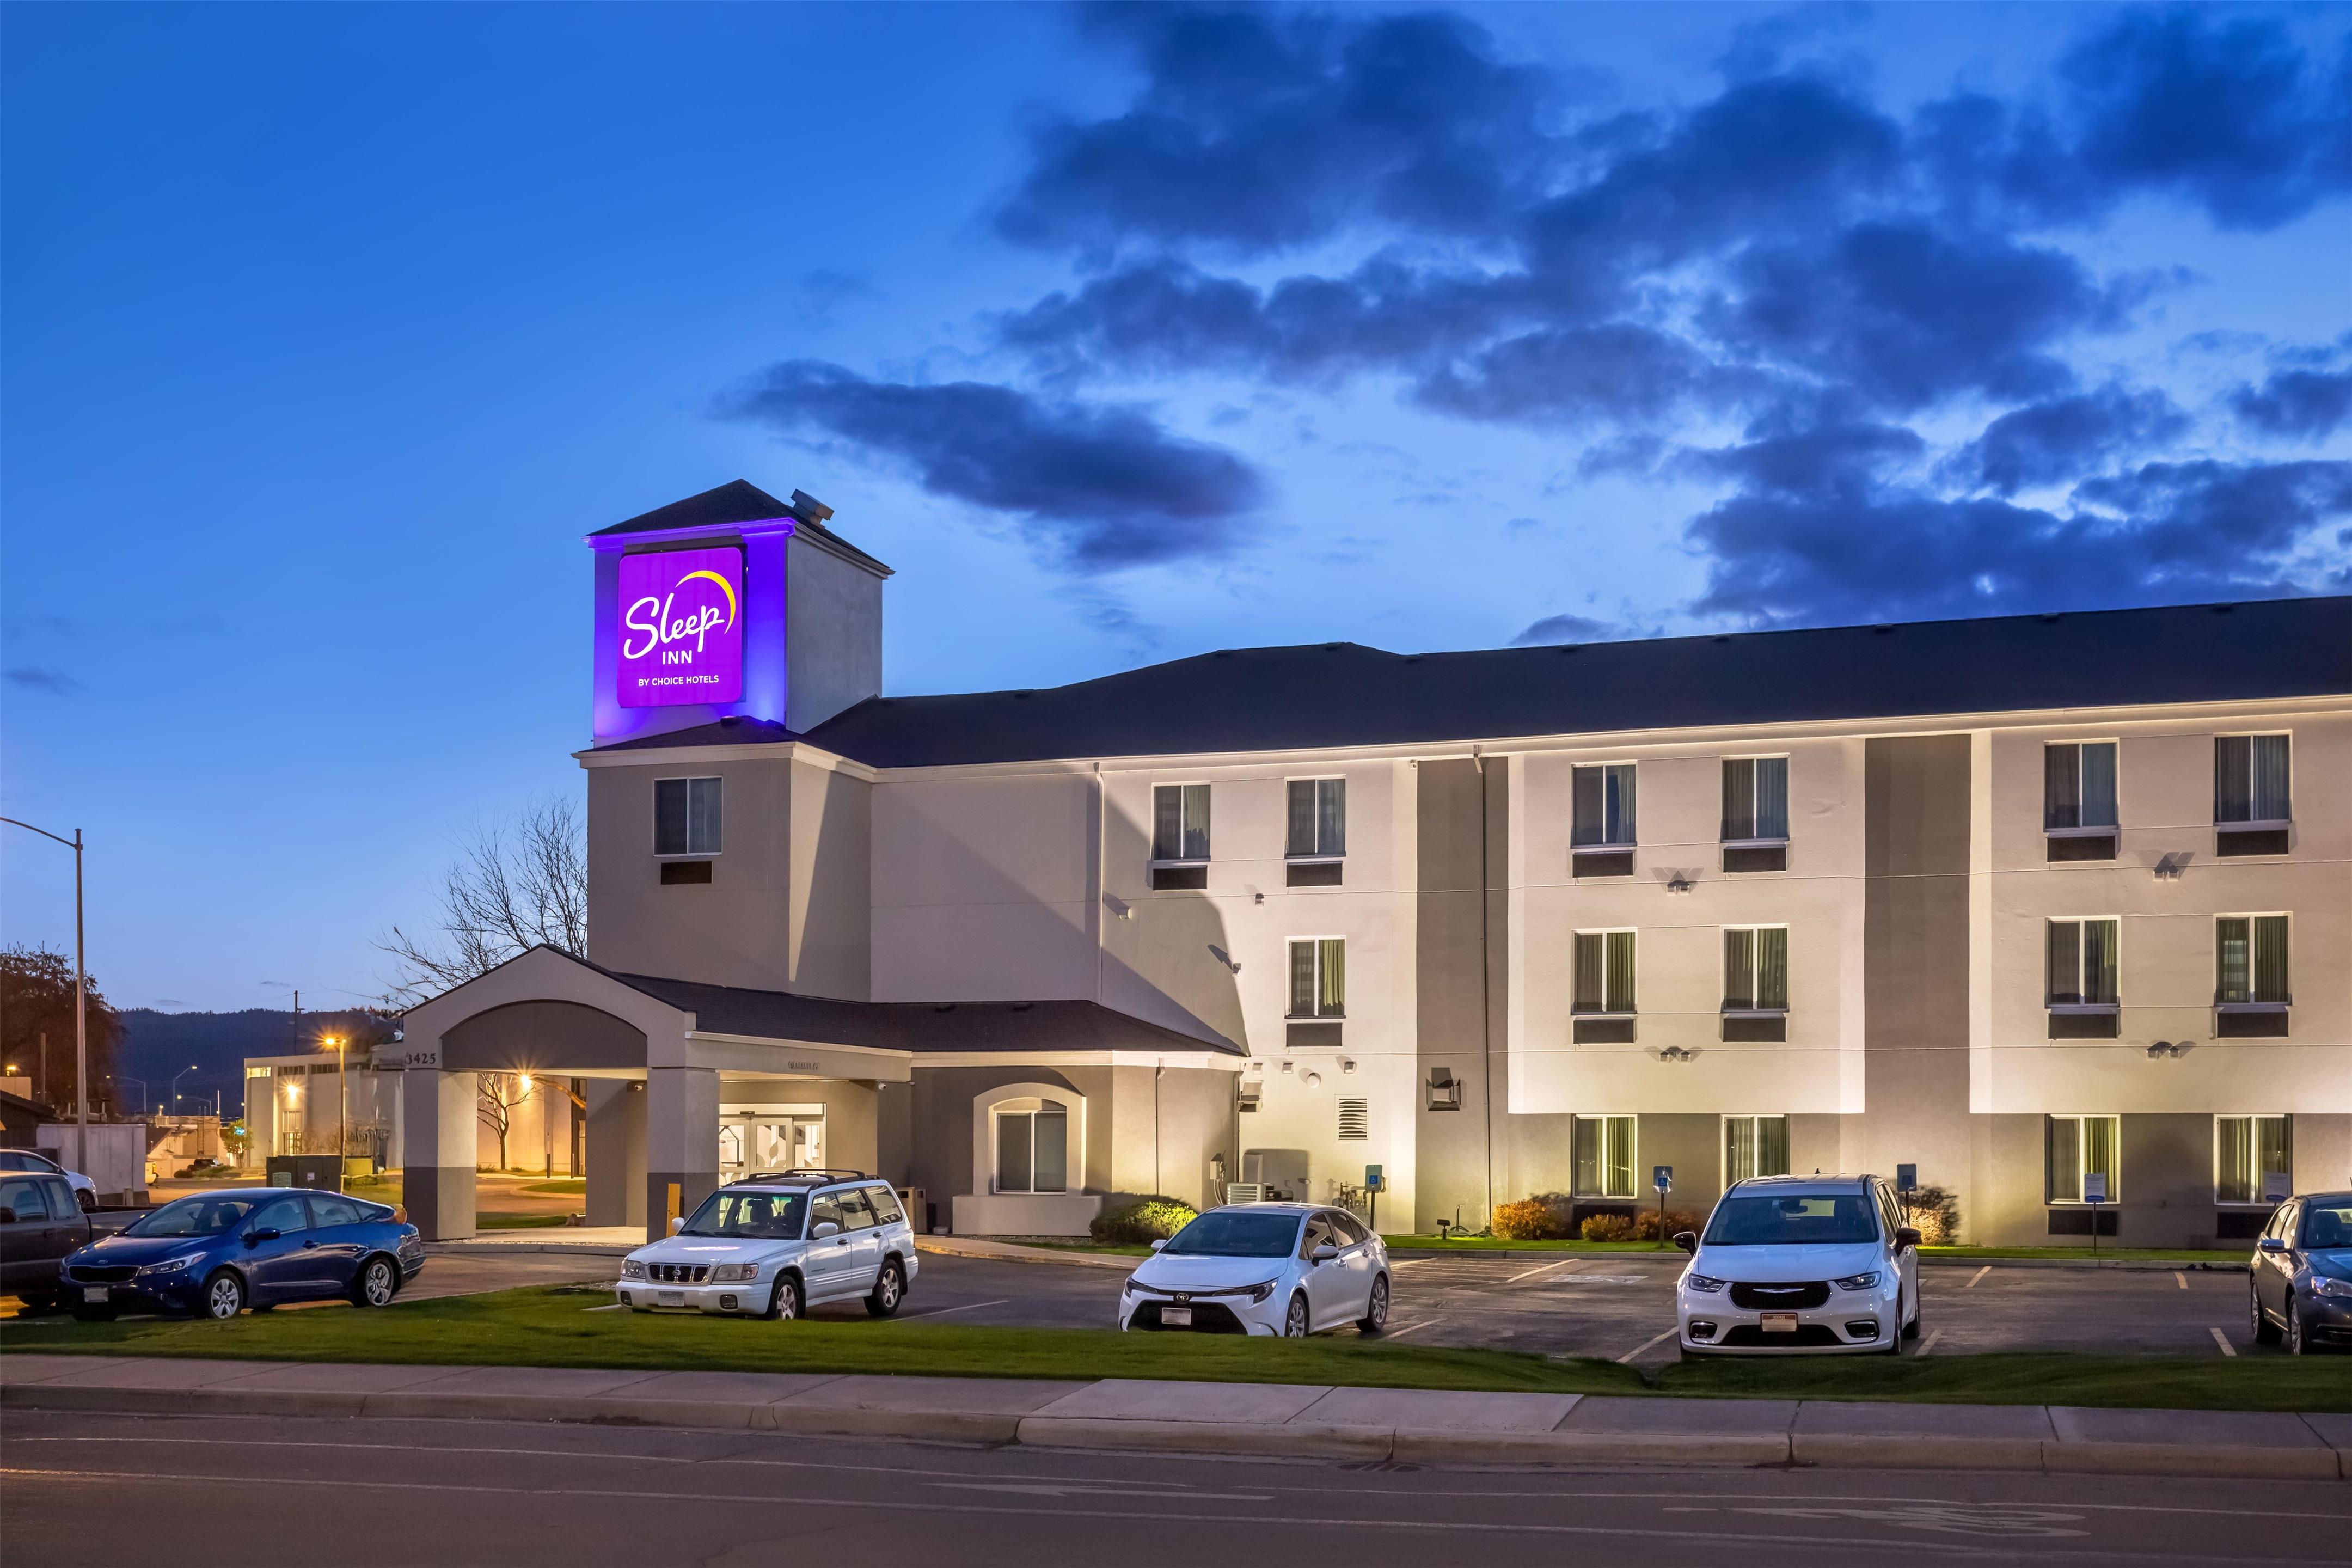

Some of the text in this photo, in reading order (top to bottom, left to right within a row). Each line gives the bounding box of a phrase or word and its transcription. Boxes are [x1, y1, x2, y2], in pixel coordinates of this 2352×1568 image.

[623, 592, 725, 659] Sleep
[662, 650, 693, 665] INN
[638, 675, 719, 687] BY CHOICE HOTELS
[405, 1052, 436, 1065] 3425
